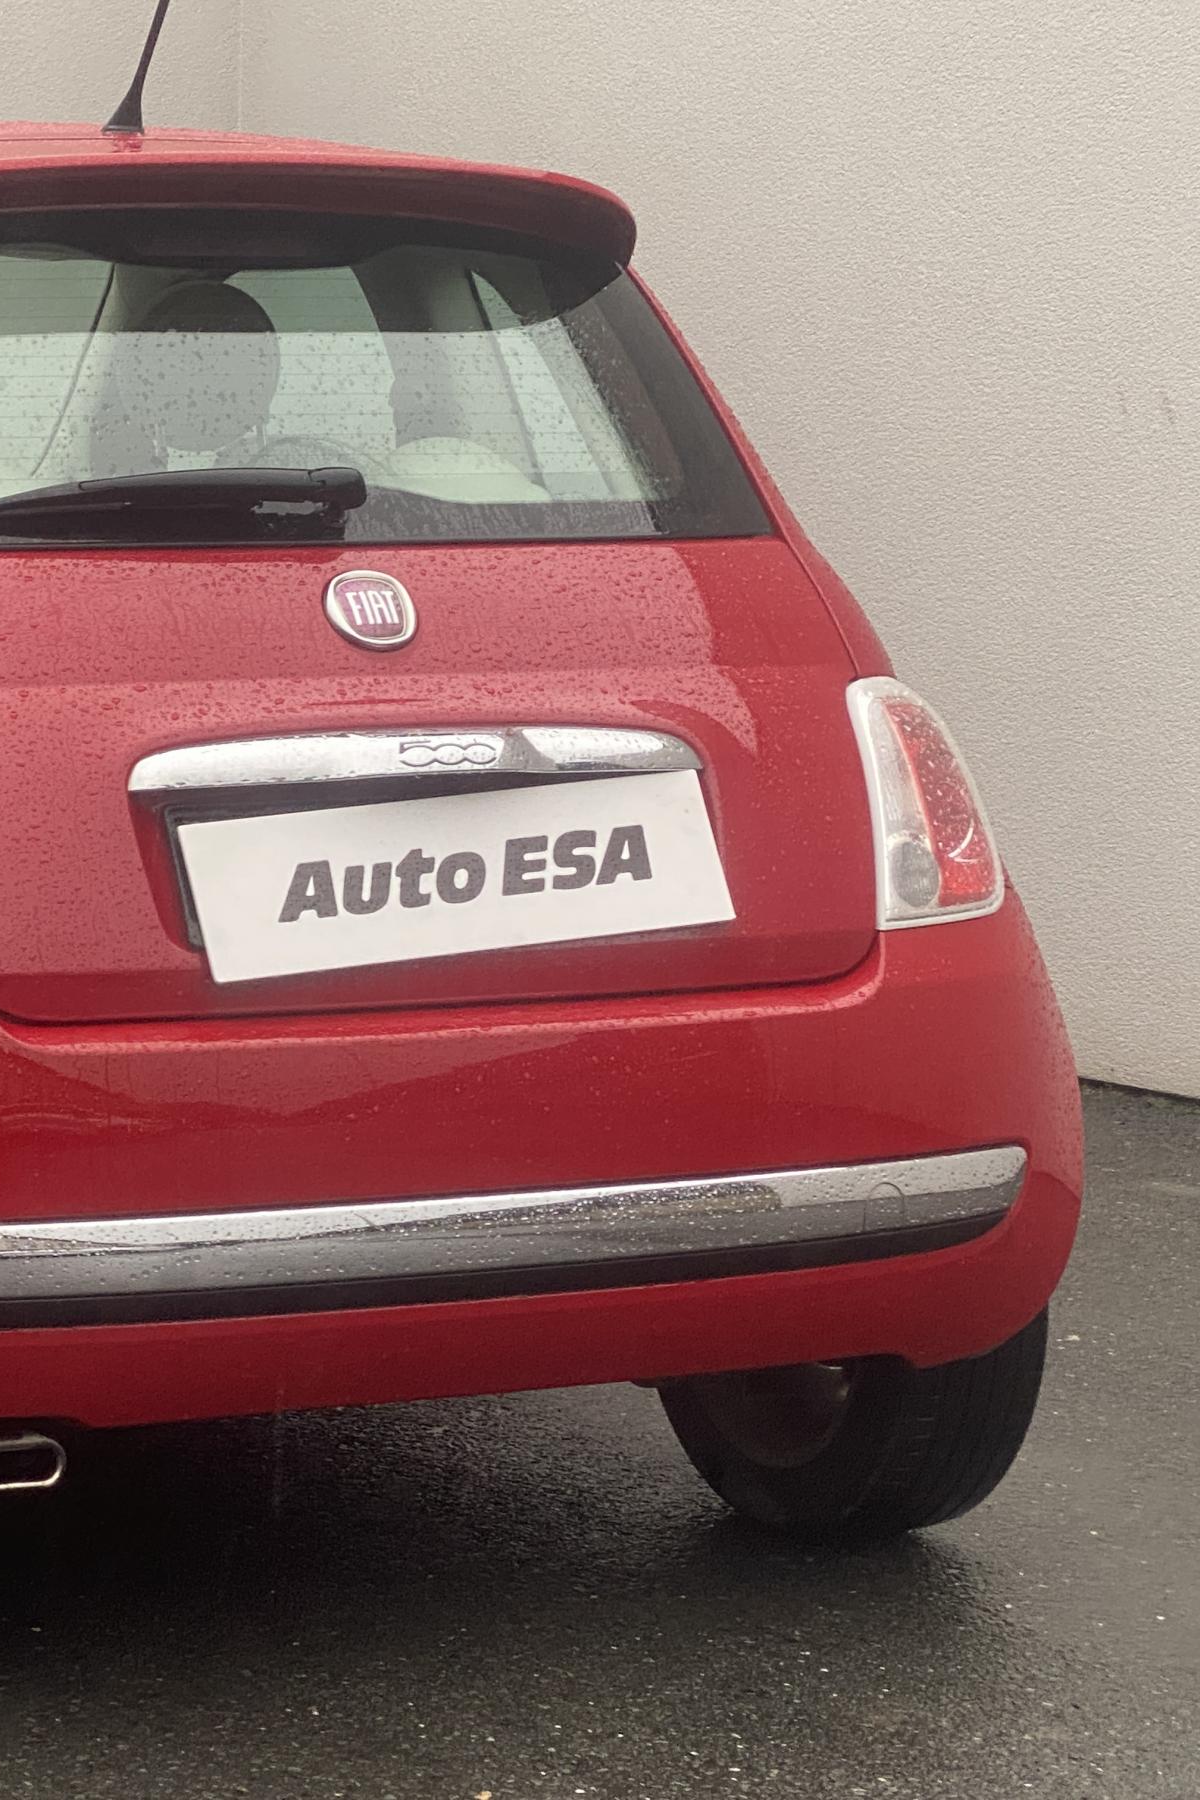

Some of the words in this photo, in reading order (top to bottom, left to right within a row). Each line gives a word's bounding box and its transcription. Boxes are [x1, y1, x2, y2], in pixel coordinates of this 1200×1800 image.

[345, 590, 400, 626] FIAT
[399, 740, 497, 768] 500
[278, 848, 487, 924] Auto
[502, 824, 653, 897] ESA
